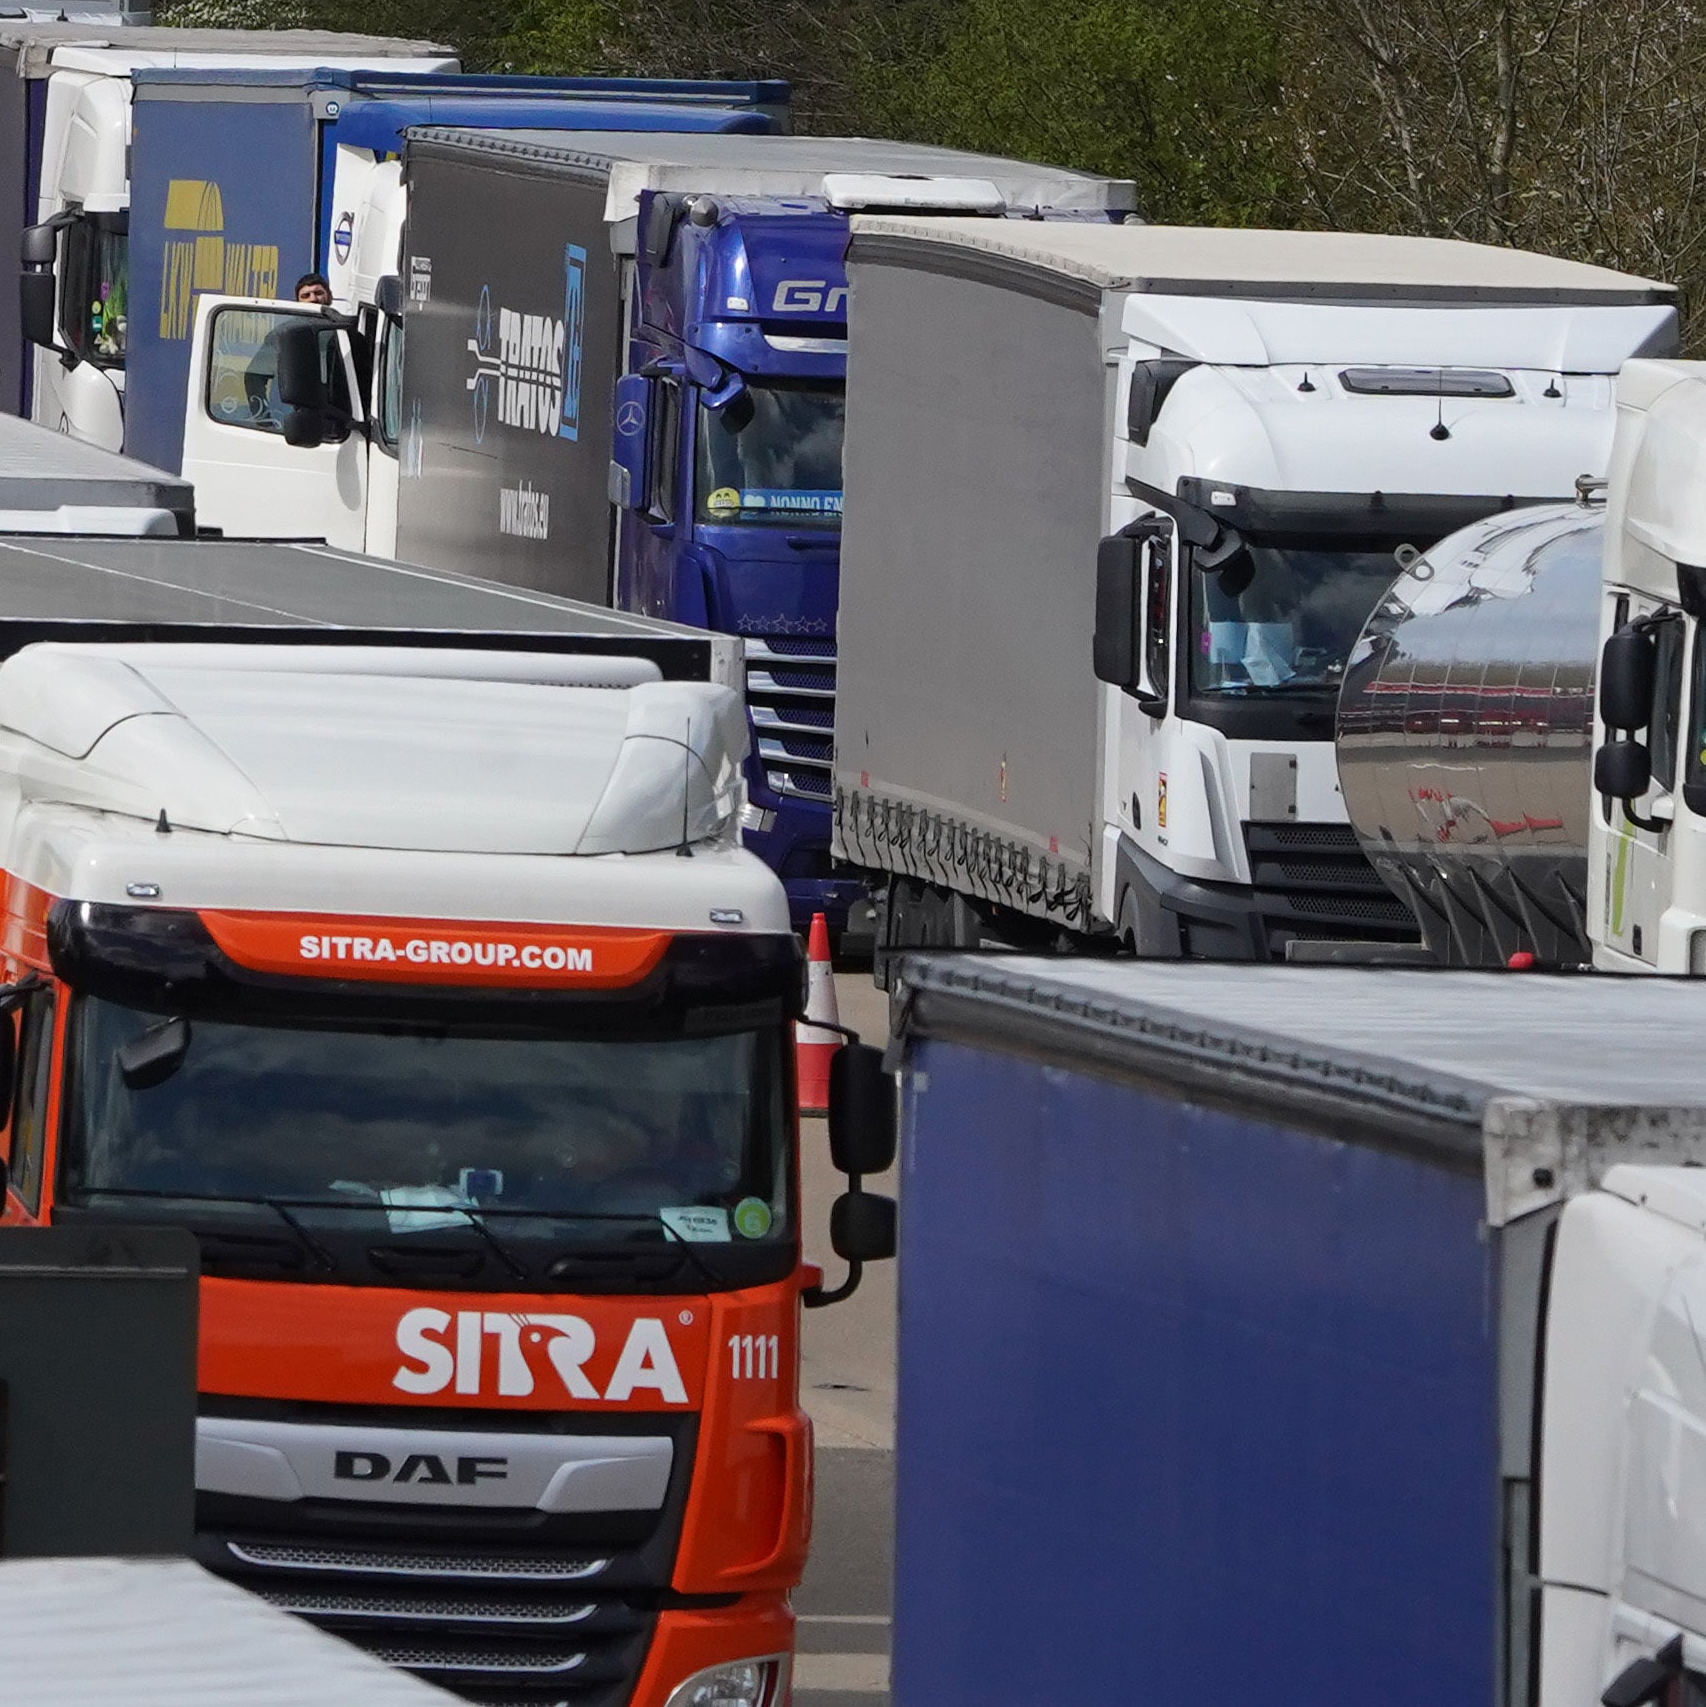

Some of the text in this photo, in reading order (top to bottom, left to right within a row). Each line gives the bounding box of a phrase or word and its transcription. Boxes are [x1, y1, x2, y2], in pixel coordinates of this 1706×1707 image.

[159, 240, 194, 340] LKW
[498, 307, 565, 437] TRATOS
[299, 935, 595, 973] SITRA-GROUP.COM
[392, 1308, 780, 1405] SITRA 1111
[333, 1451, 509, 1487] DAF
